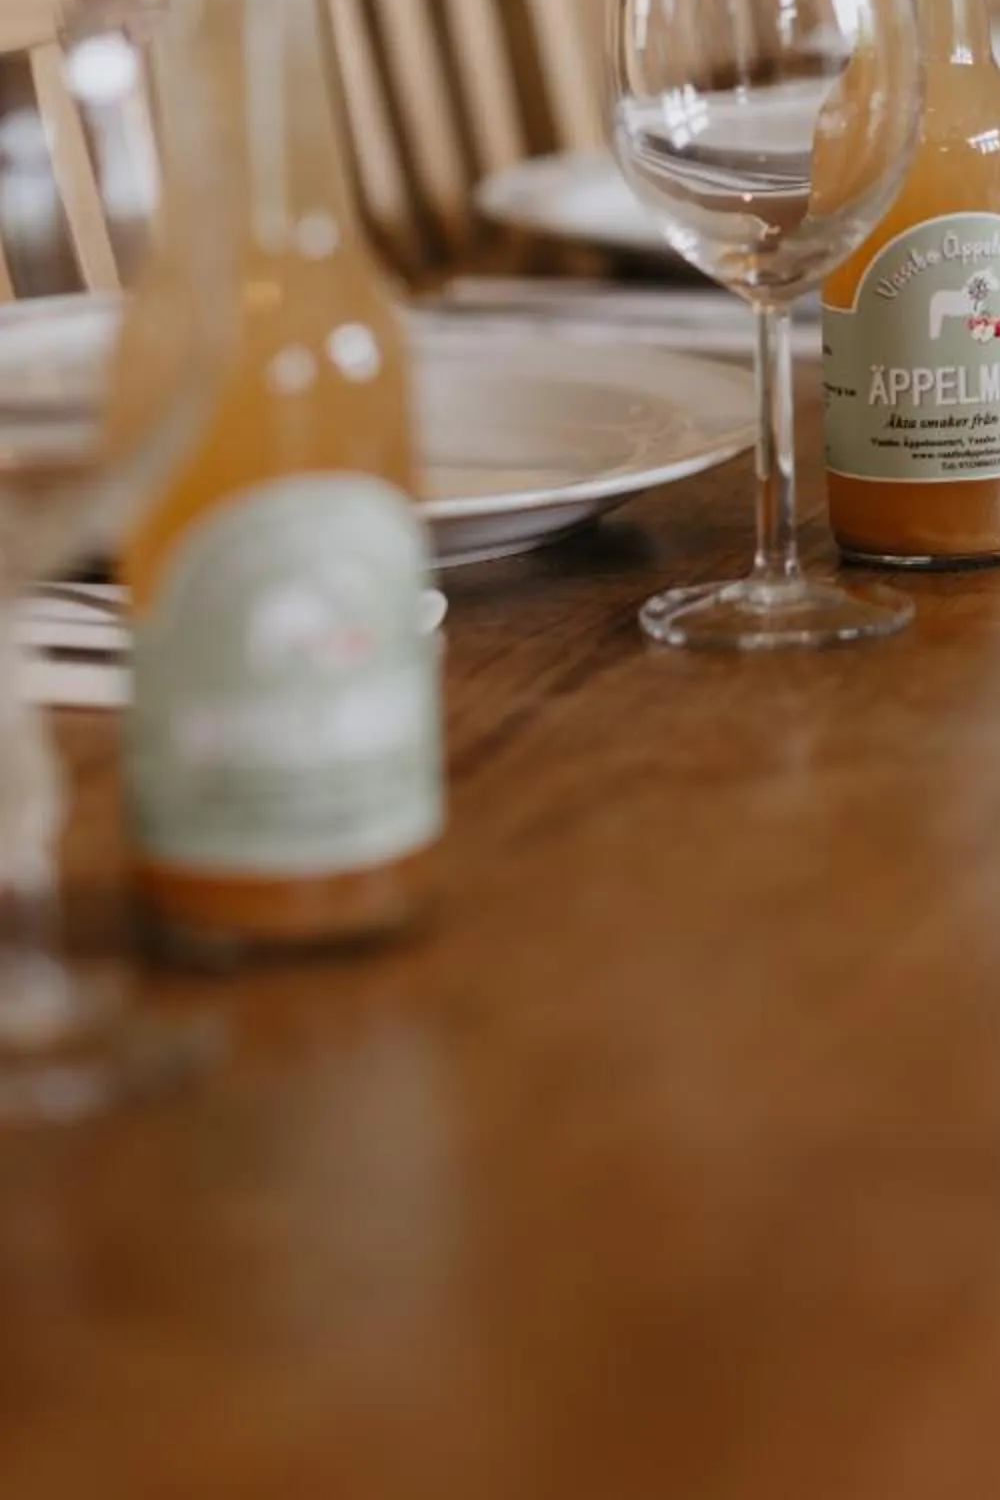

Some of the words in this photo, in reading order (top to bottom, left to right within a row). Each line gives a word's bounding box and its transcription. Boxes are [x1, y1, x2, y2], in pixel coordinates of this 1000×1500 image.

[884, 412, 917, 429] Äkta
[919, 413, 969, 429] smaker
[969, 413, 999, 430] från
